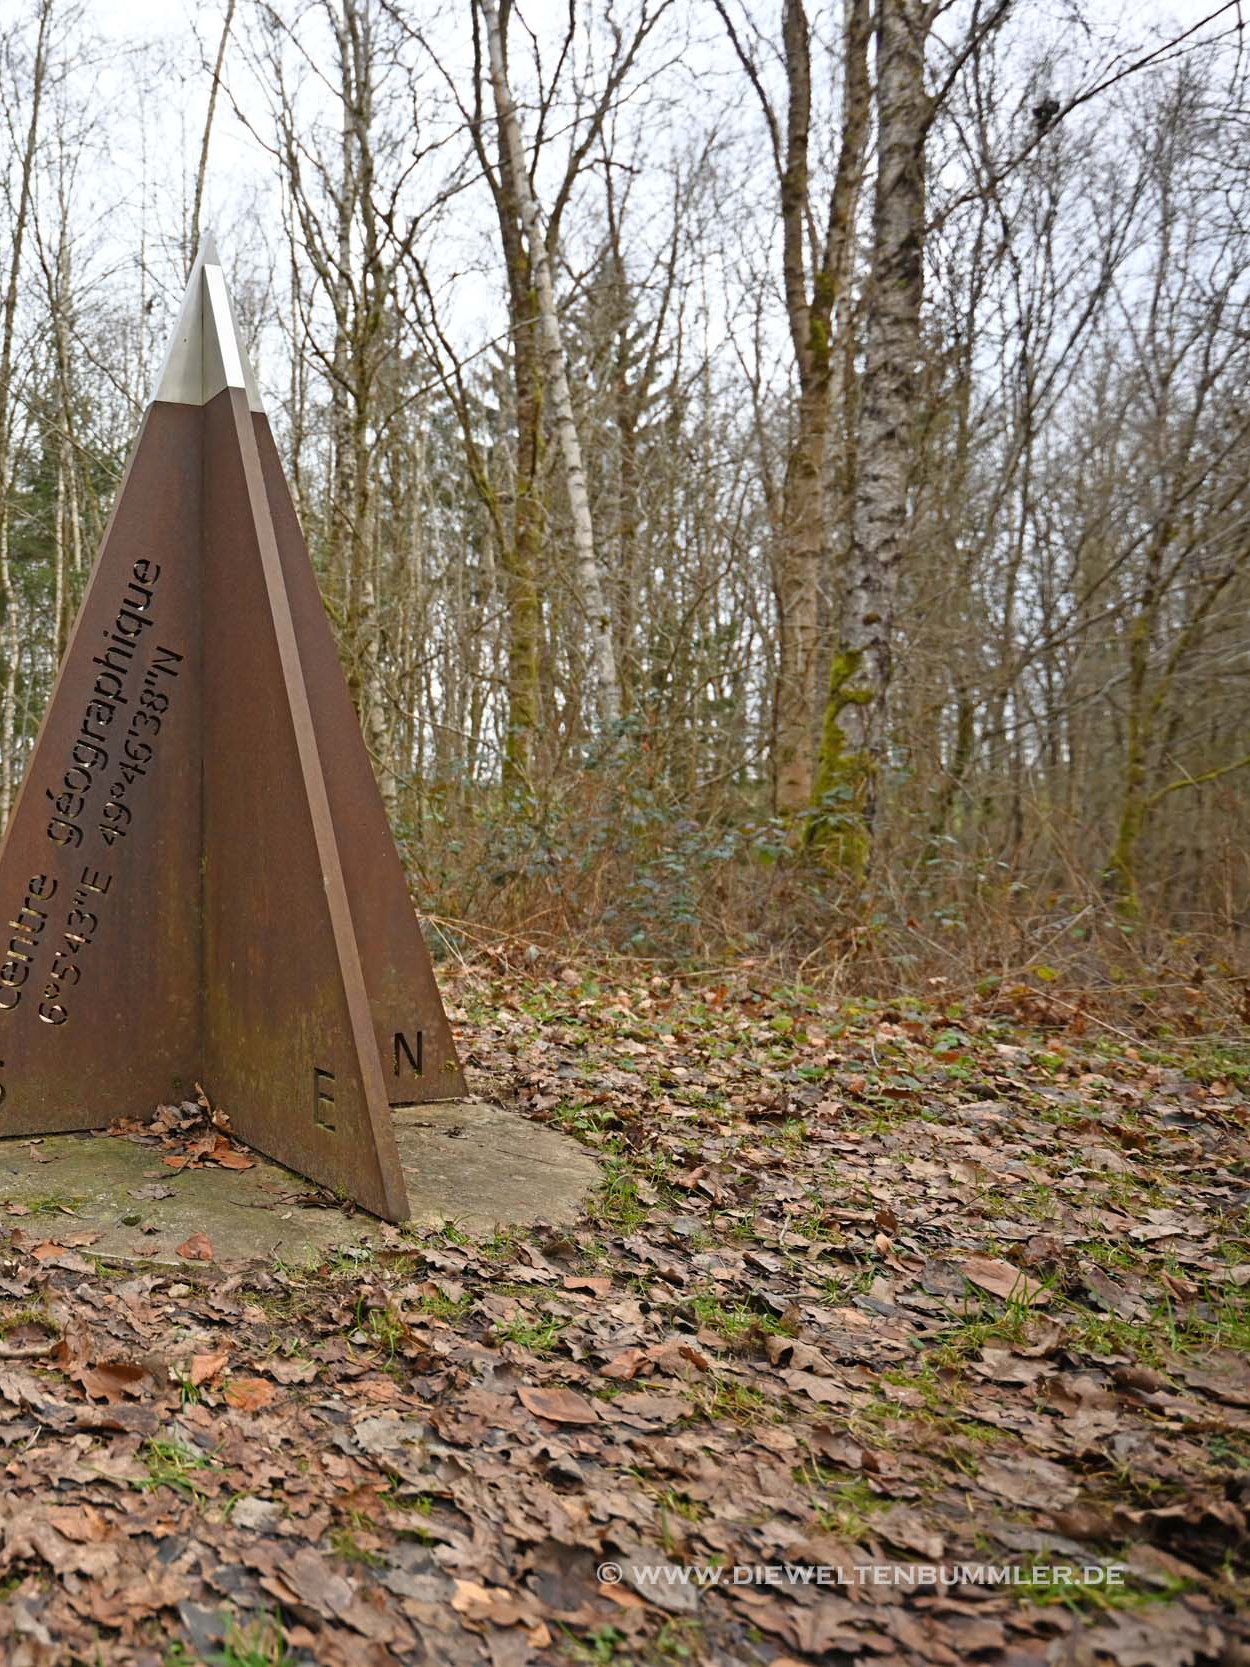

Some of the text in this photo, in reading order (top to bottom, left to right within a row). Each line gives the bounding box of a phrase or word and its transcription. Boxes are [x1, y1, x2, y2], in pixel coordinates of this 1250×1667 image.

[46, 558, 161, 848] géographique
[393, 1031, 423, 1079] N
[314, 1067, 336, 1134] E
